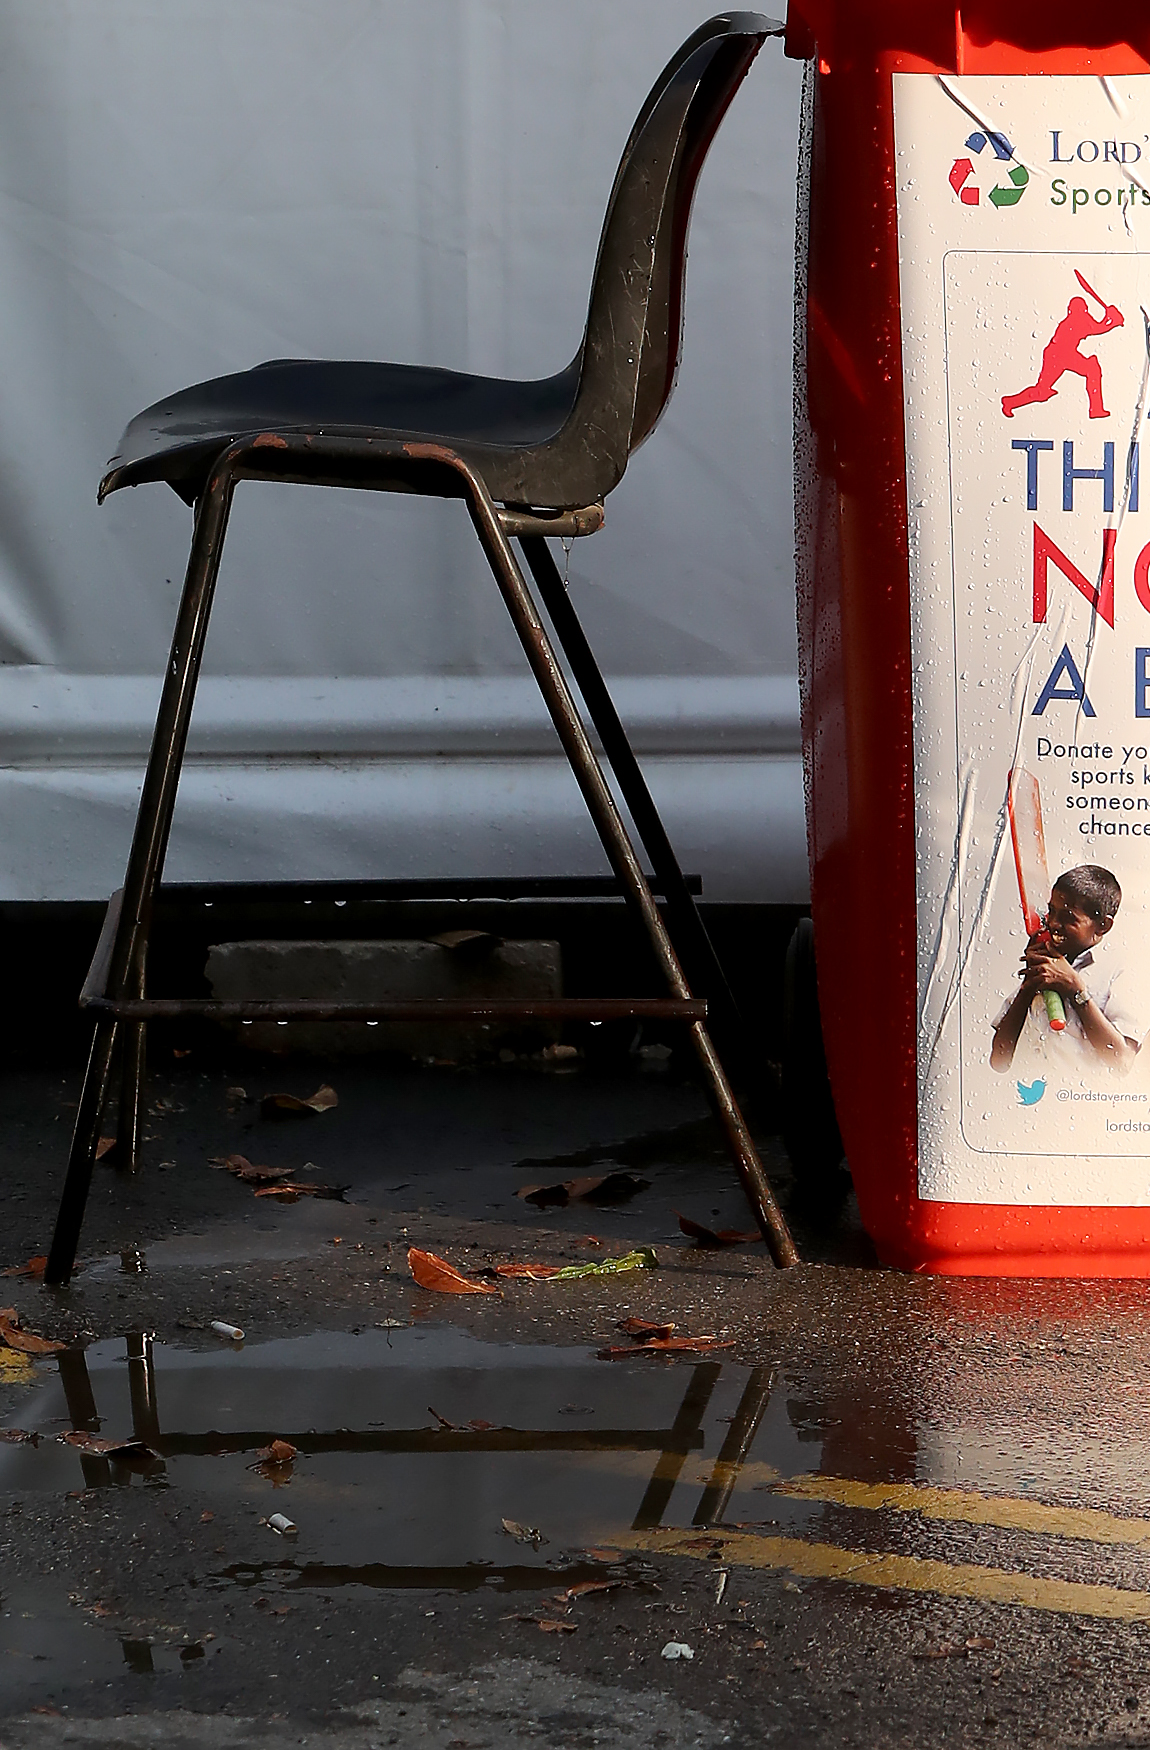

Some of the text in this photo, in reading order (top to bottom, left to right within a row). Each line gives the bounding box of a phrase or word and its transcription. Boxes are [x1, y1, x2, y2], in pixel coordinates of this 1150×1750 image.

[1031, 643, 1097, 718] A
[1036, 738, 1113, 759] Donate
[1070, 767, 1135, 790] sports
[1056, 1089, 1148, 1103] @lordstaverners
